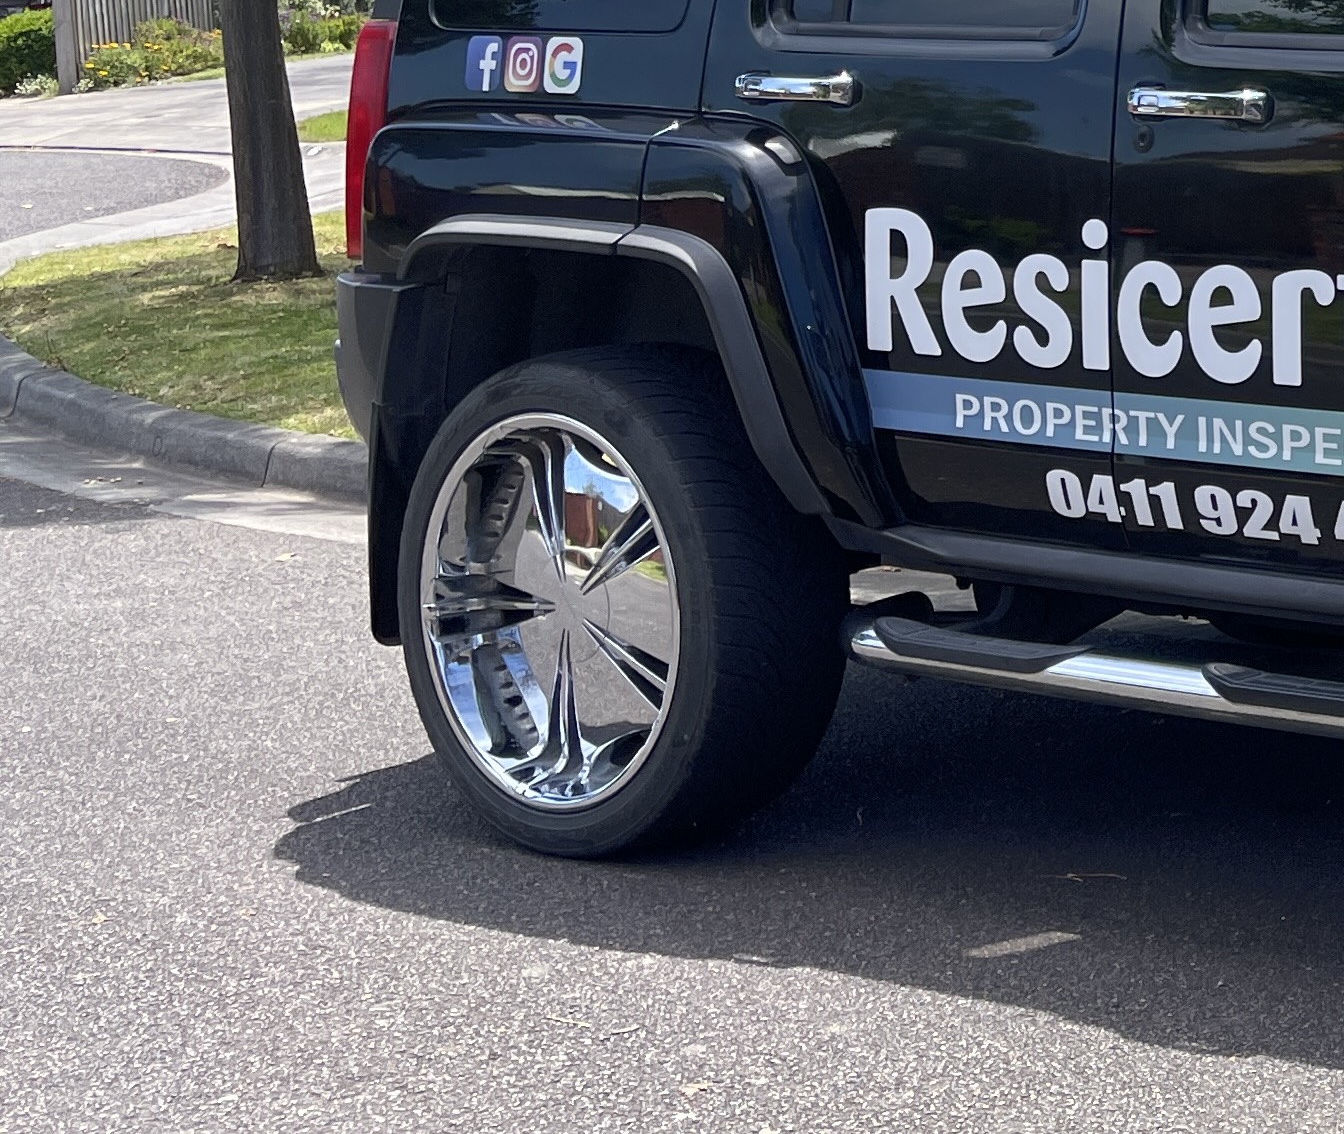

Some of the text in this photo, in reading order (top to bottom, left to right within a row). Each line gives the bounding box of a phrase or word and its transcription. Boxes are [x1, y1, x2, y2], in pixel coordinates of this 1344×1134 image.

[954, 392, 1185, 450] PROPERTY
[1045, 469, 1185, 531] 0411
[1195, 485, 1322, 546] 924
